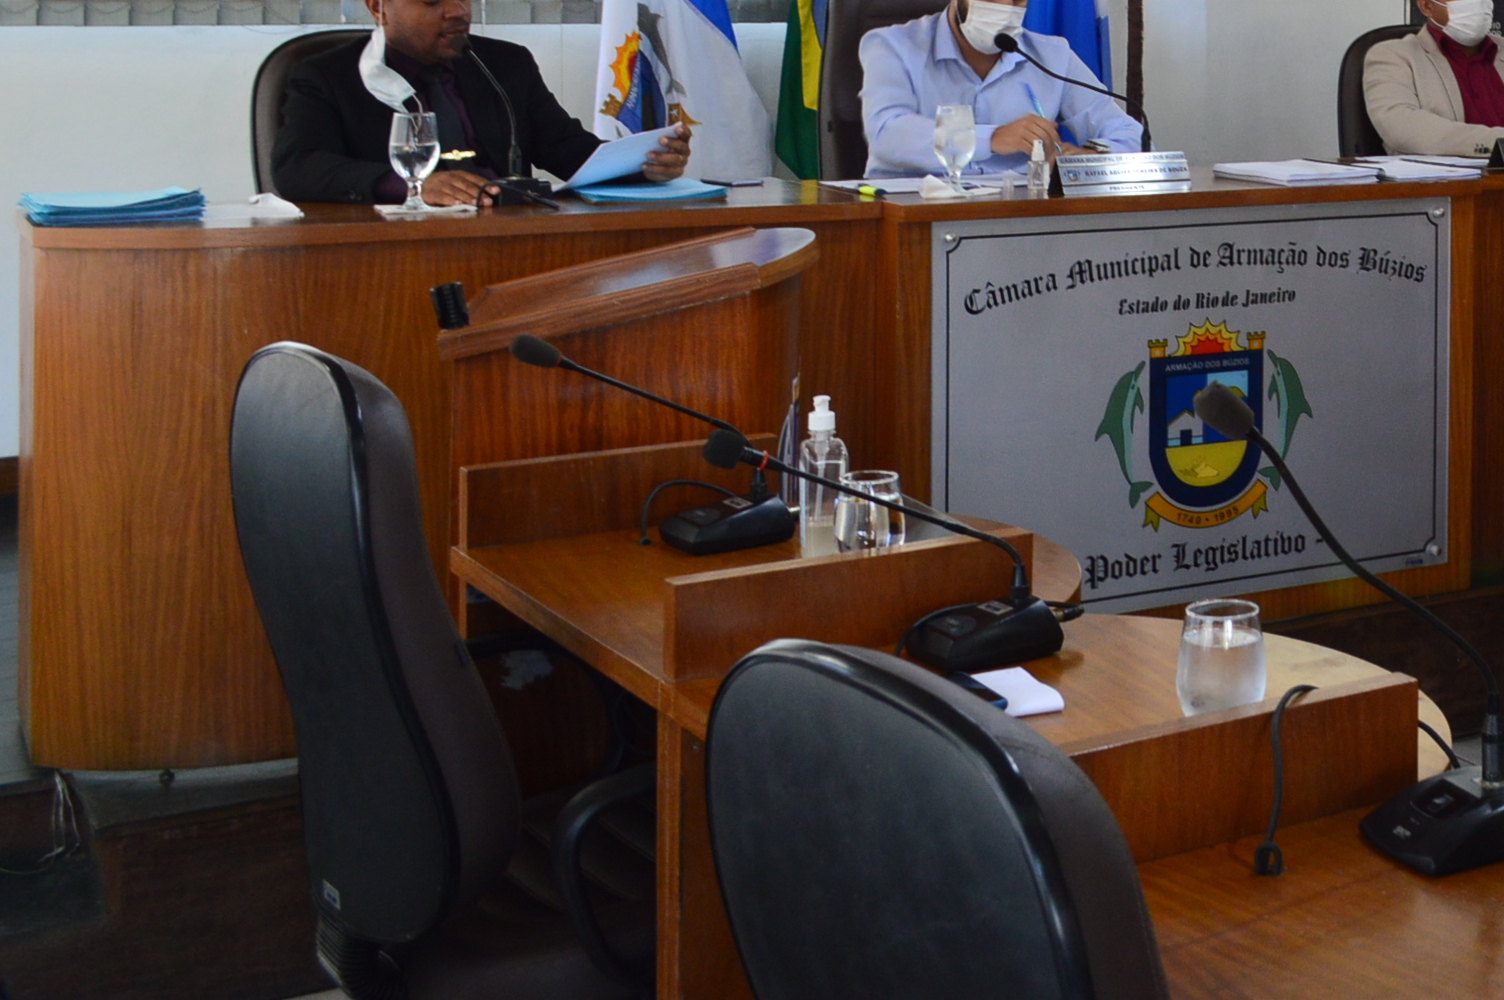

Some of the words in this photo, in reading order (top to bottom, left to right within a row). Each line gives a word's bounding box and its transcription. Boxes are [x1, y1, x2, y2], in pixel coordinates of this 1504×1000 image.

[964, 272, 1058, 315] Câmara
[1066, 247, 1182, 290] Municipal
[1189, 246, 1212, 269] de
[1217, 241, 1308, 274] Armação
[1316, 245, 1351, 269] dos
[1356, 246, 1428, 283] Búzios
[1118, 296, 1168, 316] Estado
[1173, 294, 1190, 312] do
[1241, 286, 1296, 308] Janeiro
[1165, 360, 1203, 372] ARMAÇÃO
[1204, 360, 1221, 369] DOS
[1214, 505, 1239, 522] 1995
[1084, 552, 1162, 590] Poder
[1171, 530, 1306, 572] Legislativo
